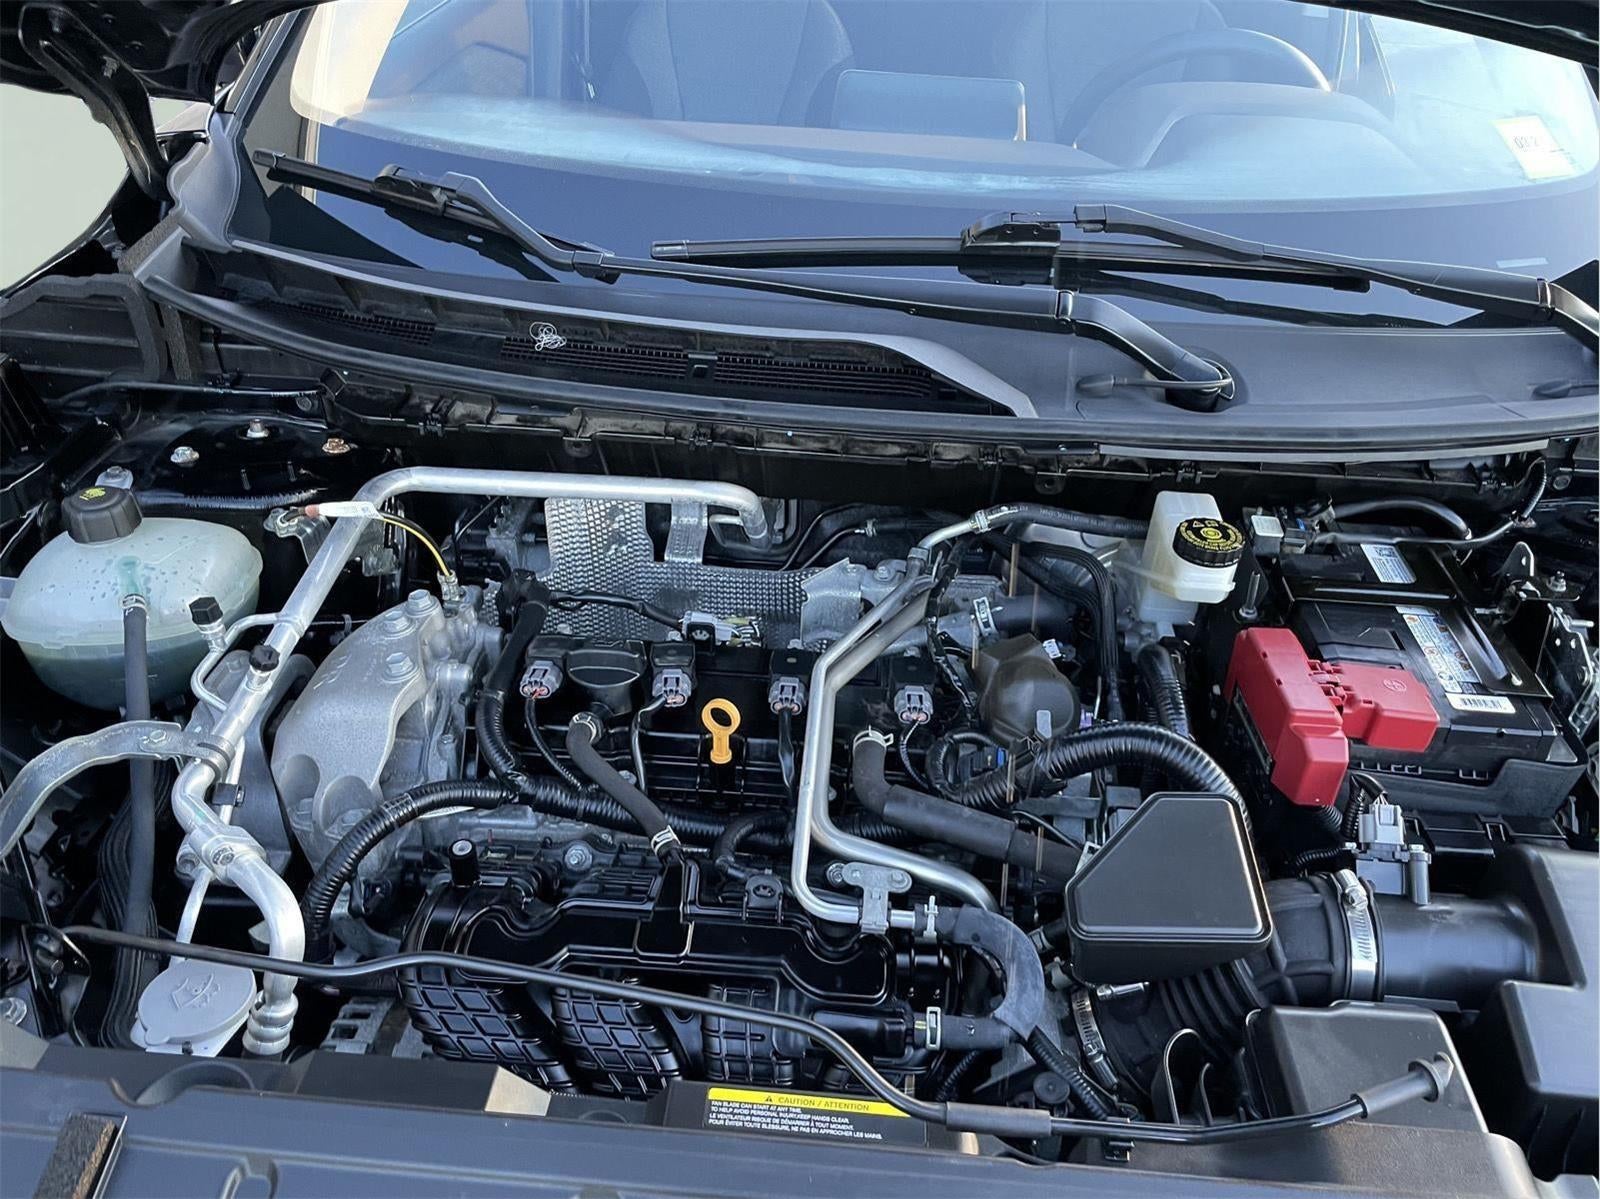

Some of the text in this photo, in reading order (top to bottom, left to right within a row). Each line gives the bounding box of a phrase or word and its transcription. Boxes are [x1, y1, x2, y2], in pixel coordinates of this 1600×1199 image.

[778, 1097, 815, 1106] CAUTION
[824, 1101, 870, 1111] ATTENTION
[750, 1109, 778, 1117] PERSONAL
[812, 1114, 830, 1122] HANDS
[819, 1129, 853, 1137] APPROCHER
